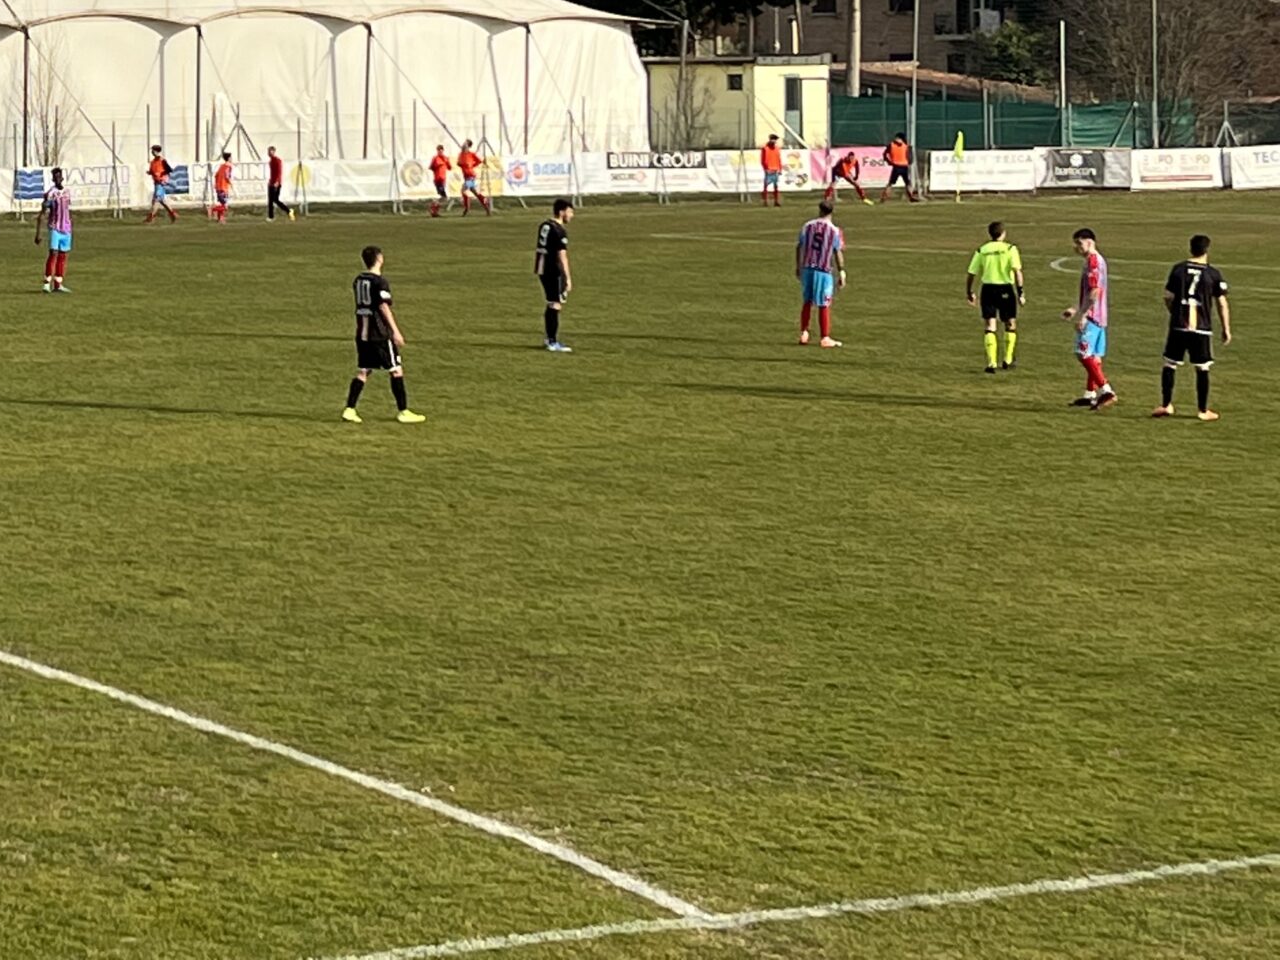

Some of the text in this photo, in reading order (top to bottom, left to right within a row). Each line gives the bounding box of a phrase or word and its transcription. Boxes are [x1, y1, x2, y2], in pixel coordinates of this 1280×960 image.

[609, 152, 702, 168] BUINI GROUP
[539, 224, 551, 246] 9
[356, 279, 372, 305] 10
[1187, 268, 1202, 295] 7
